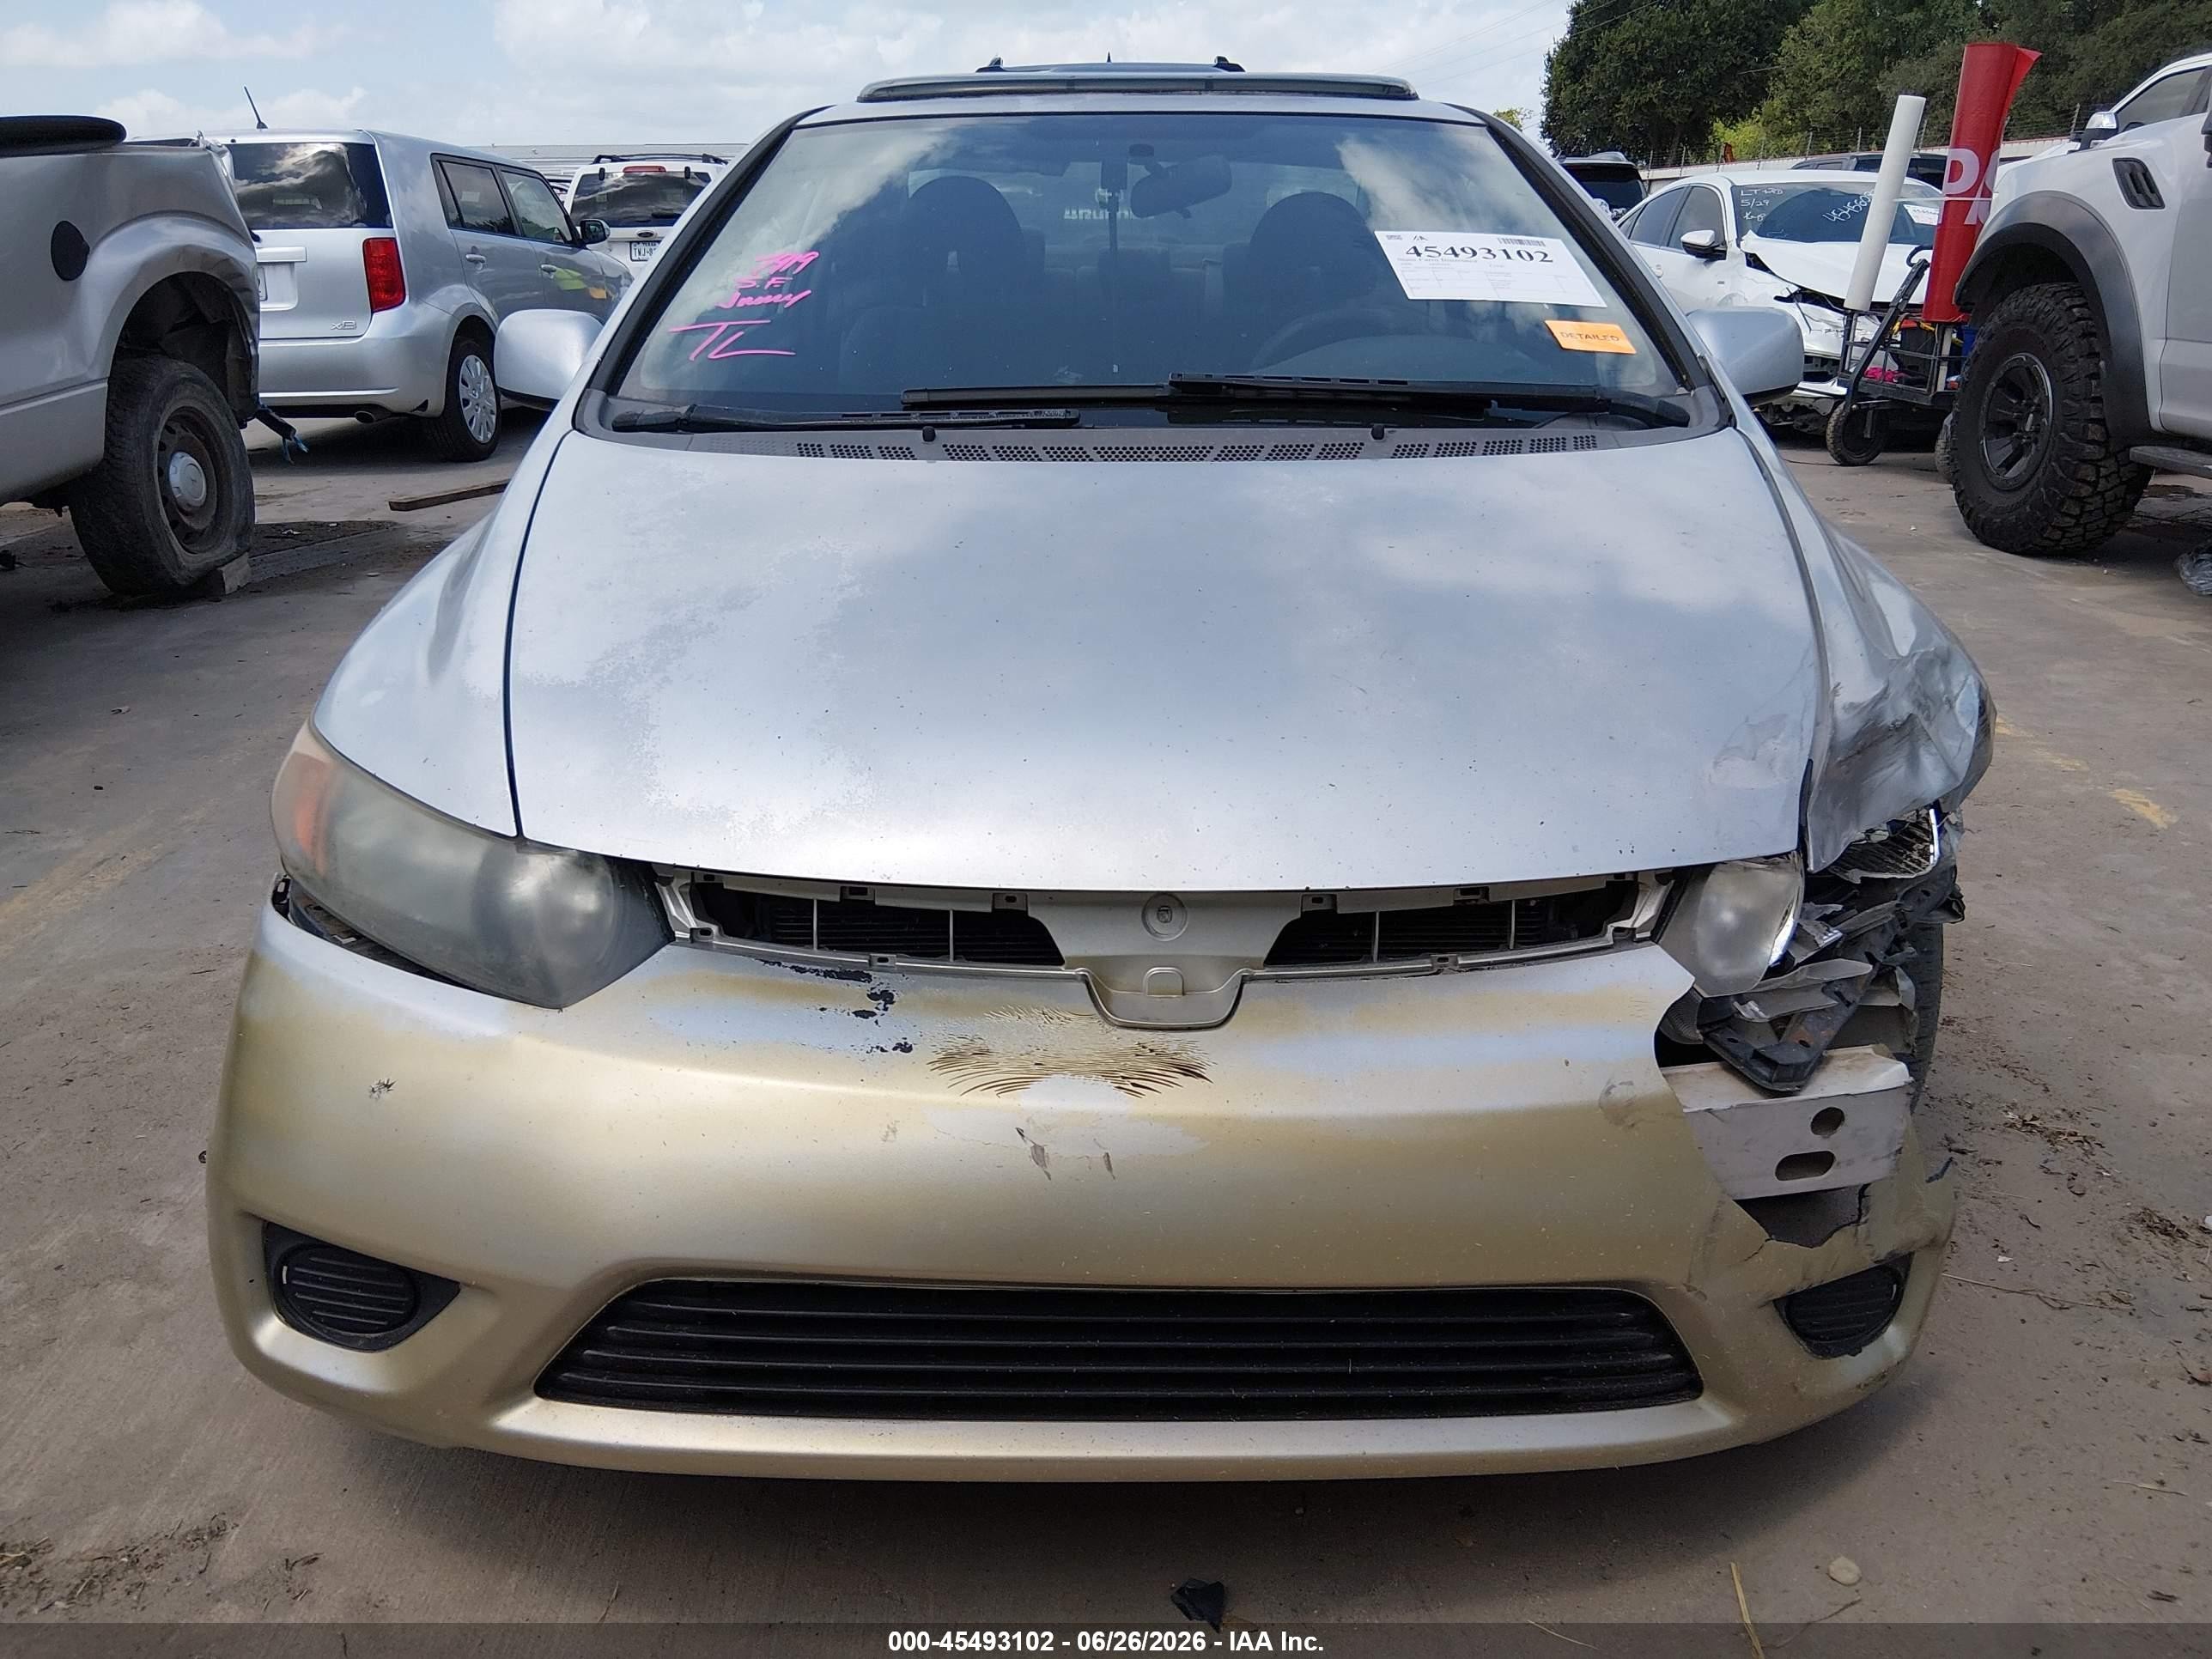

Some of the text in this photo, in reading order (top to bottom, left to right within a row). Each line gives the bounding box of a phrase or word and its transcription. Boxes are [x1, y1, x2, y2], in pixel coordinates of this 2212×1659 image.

[1741, 198, 1770, 209] 5/29
[1406, 245, 1553, 263] 45493102
[1559, 331, 1620, 342] DETAILED
